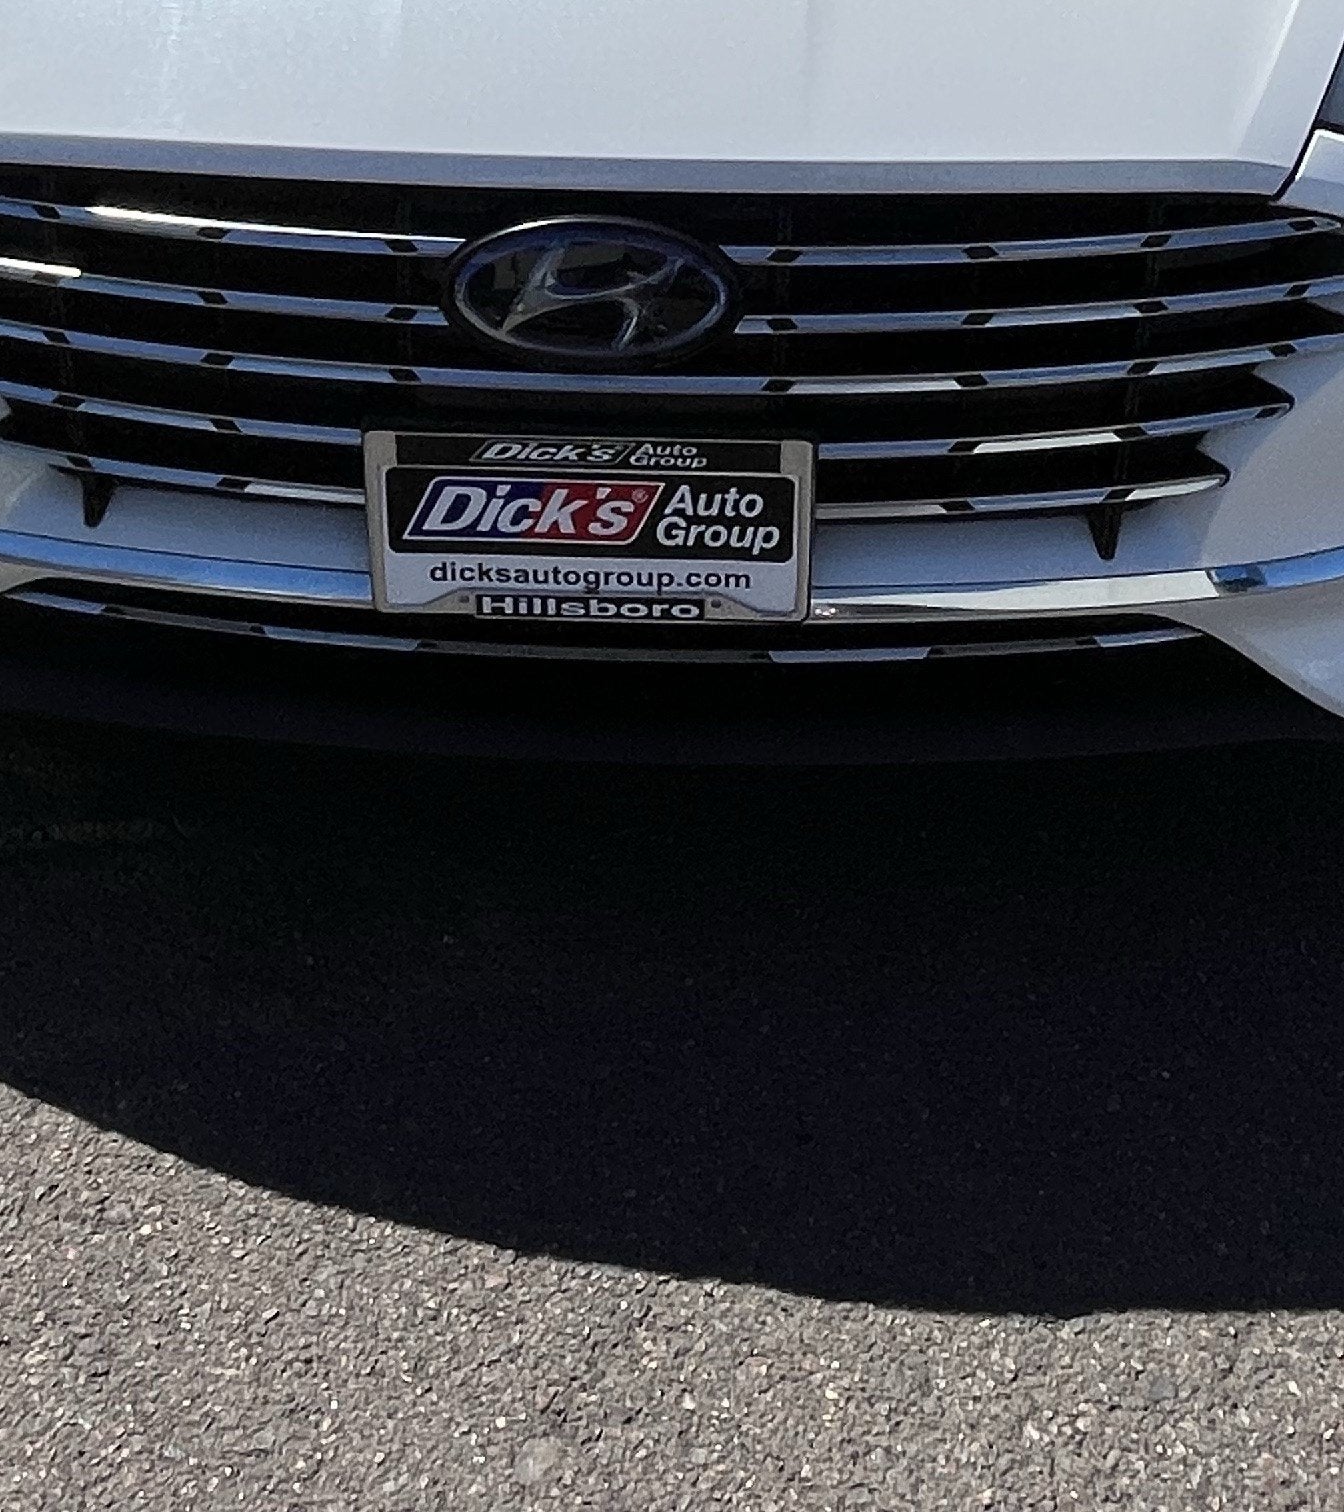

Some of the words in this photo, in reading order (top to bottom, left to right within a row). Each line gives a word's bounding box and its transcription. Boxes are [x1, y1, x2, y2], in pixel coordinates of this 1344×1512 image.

[482, 442, 617, 463] Dick's
[633, 443, 698, 456] Auto
[629, 454, 707, 469] Group
[421, 484, 635, 536] Dick's
[664, 484, 764, 517] Auto
[656, 516, 780, 555] Group
[429, 561, 751, 595] dicksautogroup.com
[480, 596, 701, 618] Hillsboro
